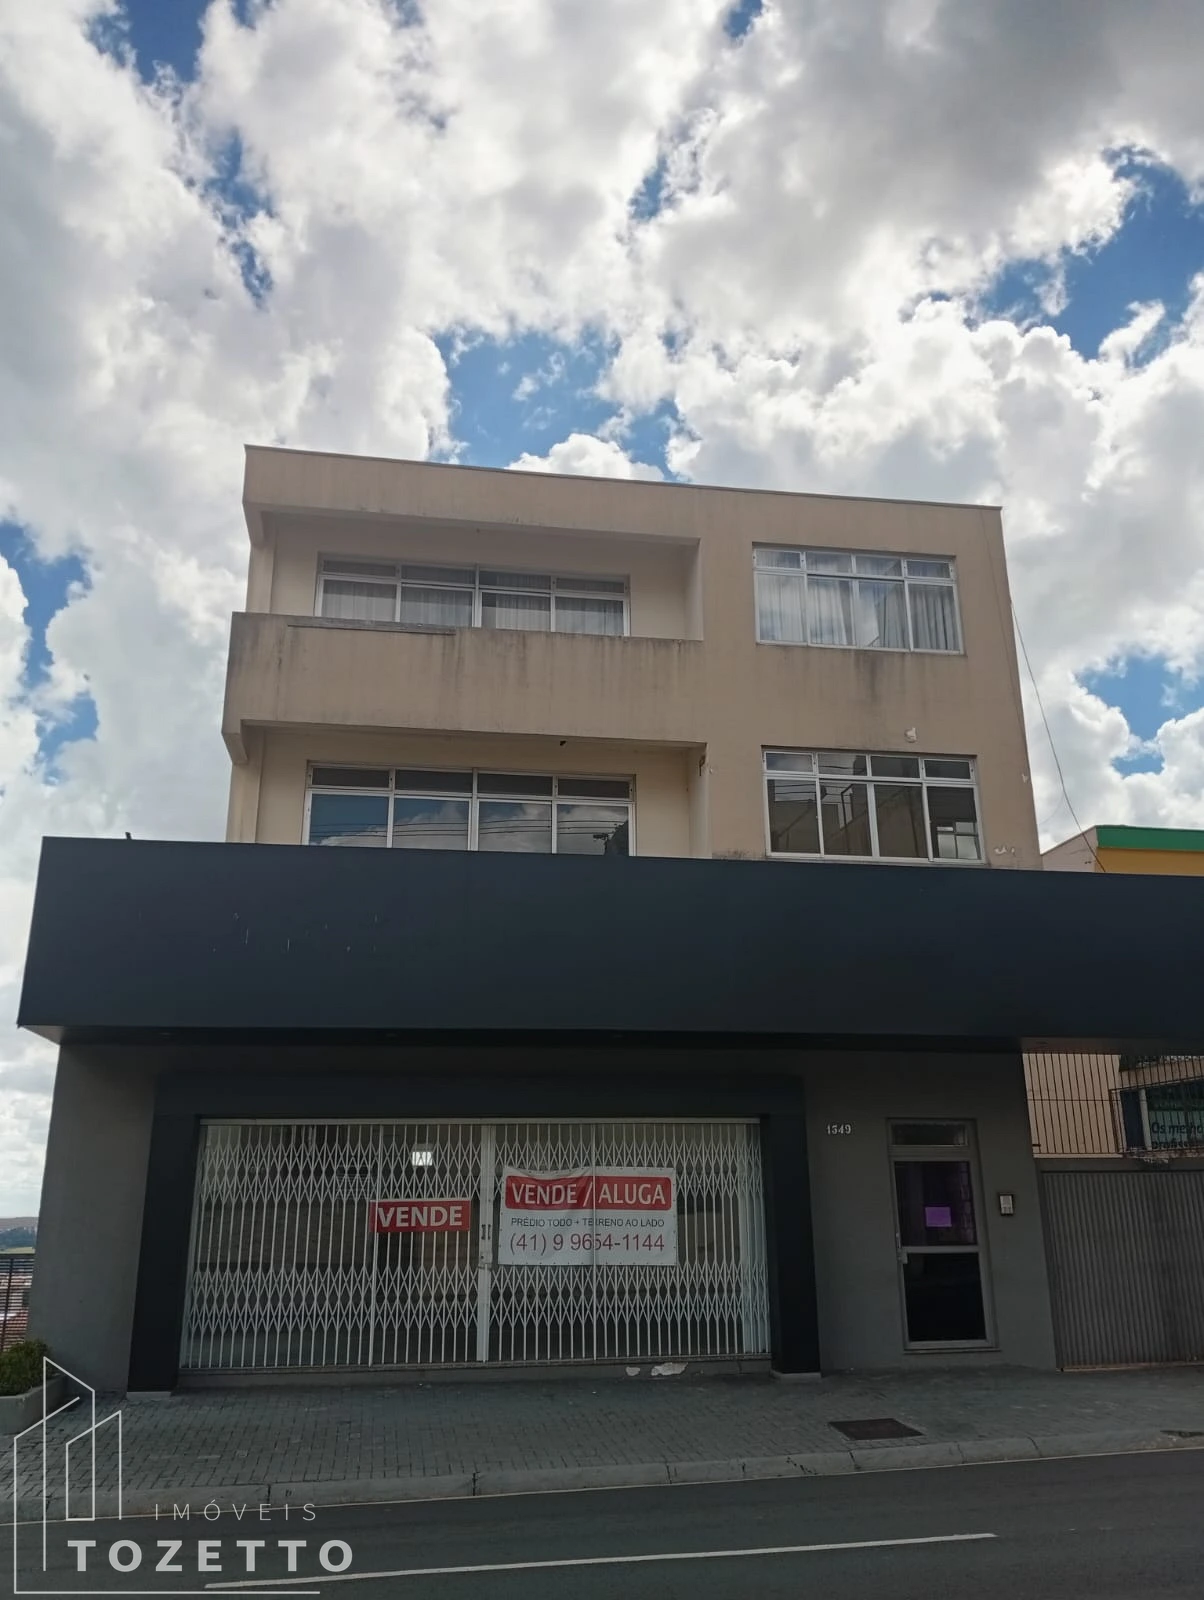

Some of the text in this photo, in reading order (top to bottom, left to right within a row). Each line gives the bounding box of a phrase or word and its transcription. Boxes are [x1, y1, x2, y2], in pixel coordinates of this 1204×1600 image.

[511, 1182, 578, 1205] VENDE
[598, 1183, 666, 1205] ALUGA
[377, 1206, 463, 1228] VENDE
[511, 1216, 545, 1228] PRÉDIO
[547, 1218, 573, 1227] TODO
[626, 1219, 638, 1227] AO
[641, 1219, 665, 1228] LADO
[510, 1233, 665, 1255] (41) 9 9654-1144
